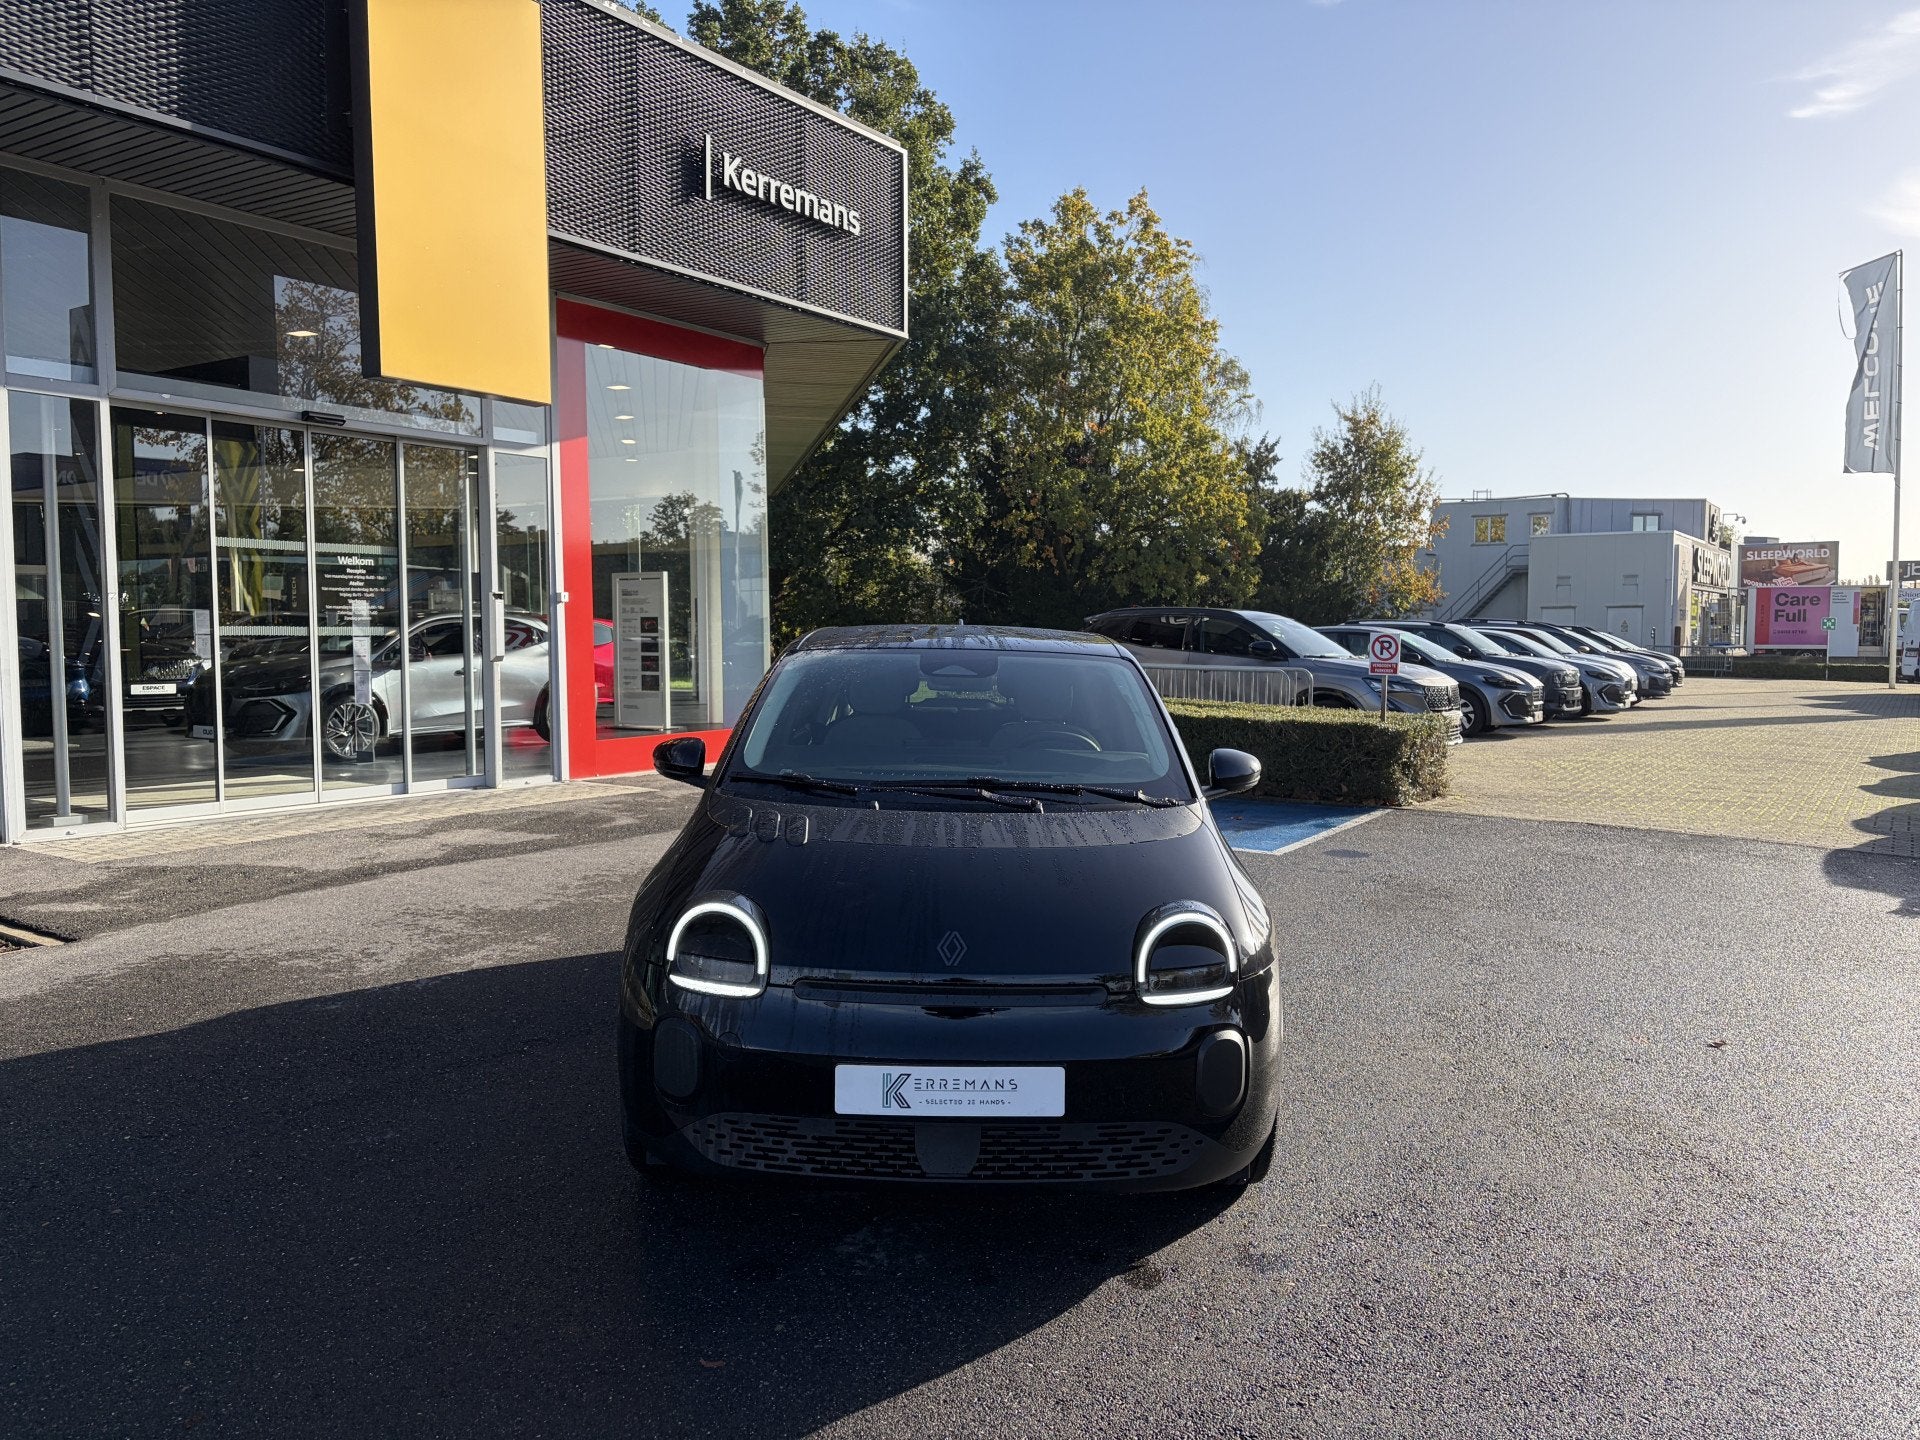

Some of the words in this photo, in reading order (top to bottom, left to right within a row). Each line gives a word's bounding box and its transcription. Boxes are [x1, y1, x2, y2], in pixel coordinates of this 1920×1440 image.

[722, 151, 861, 236] Kerremans
[337, 556, 374, 566] Welkom
[1746, 548, 1830, 561] SLEEPWORLD
[1775, 592, 1821, 607] Care
[1774, 609, 1807, 622] Full
